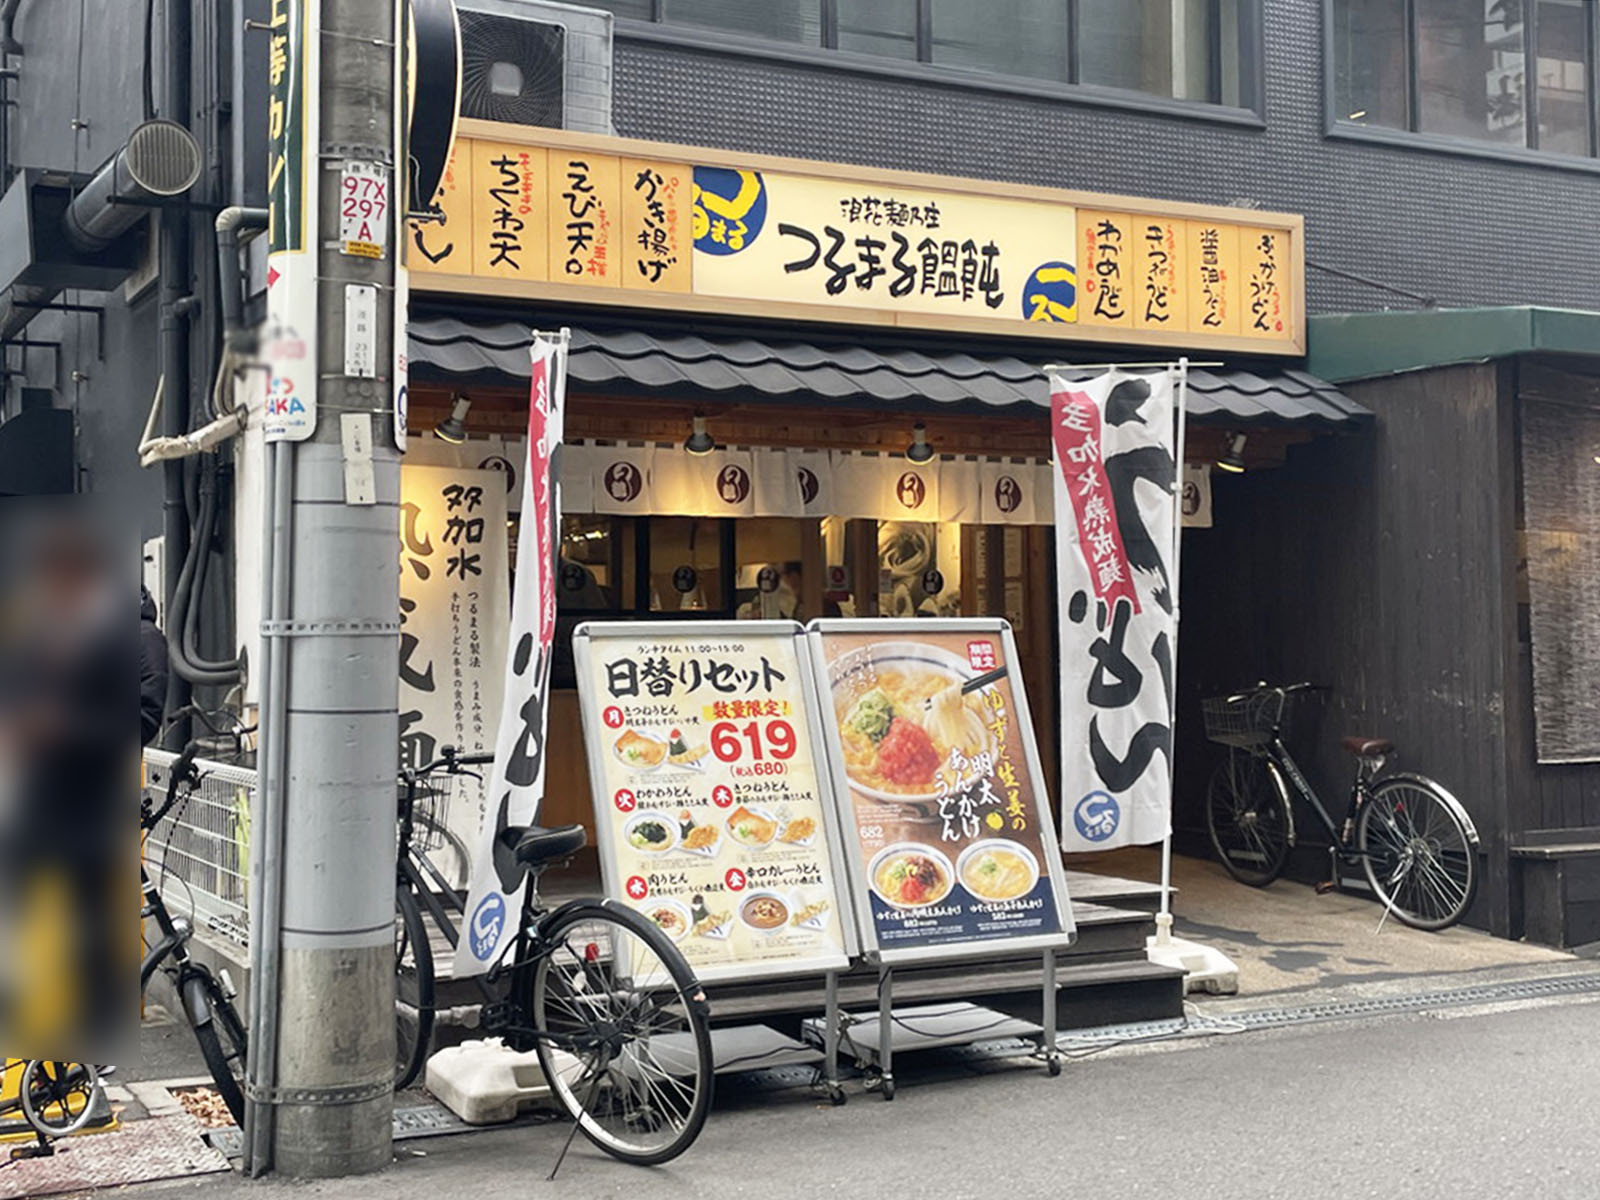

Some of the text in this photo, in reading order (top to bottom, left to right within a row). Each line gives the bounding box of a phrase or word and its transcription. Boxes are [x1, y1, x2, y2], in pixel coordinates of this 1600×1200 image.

[342, 197, 386, 221] 297
[343, 175, 387, 202] 97X
[358, 220, 373, 241] A
[489, 154, 524, 270] ちくわ天
[634, 168, 677, 283] かき揚げ
[777, 221, 1005, 310] つるまる饂飩
[1093, 218, 1125, 320] わかめうどん
[1145, 225, 1169, 323] きつねうどん
[467, 591, 481, 668] つるまる製法
[604, 656, 786, 699] 日替りセット
[624, 703, 679, 717] きつねうどん
[710, 719, 797, 763] 619
[982, 689, 1027, 831] ゆずと生姜の
[636, 785, 692, 799] わかめうどん
[716, 787, 731, 805] 木
[734, 780, 789, 795] きつねうどん
[950, 746, 980, 838] あんかけ
[970, 750, 1002, 805] 明太
[934, 771, 961, 842] うどん
[648, 872, 688, 887] 肉うどん
[727, 871, 744, 888] 金
[745, 862, 820, 878] 辛口カレーうどん
